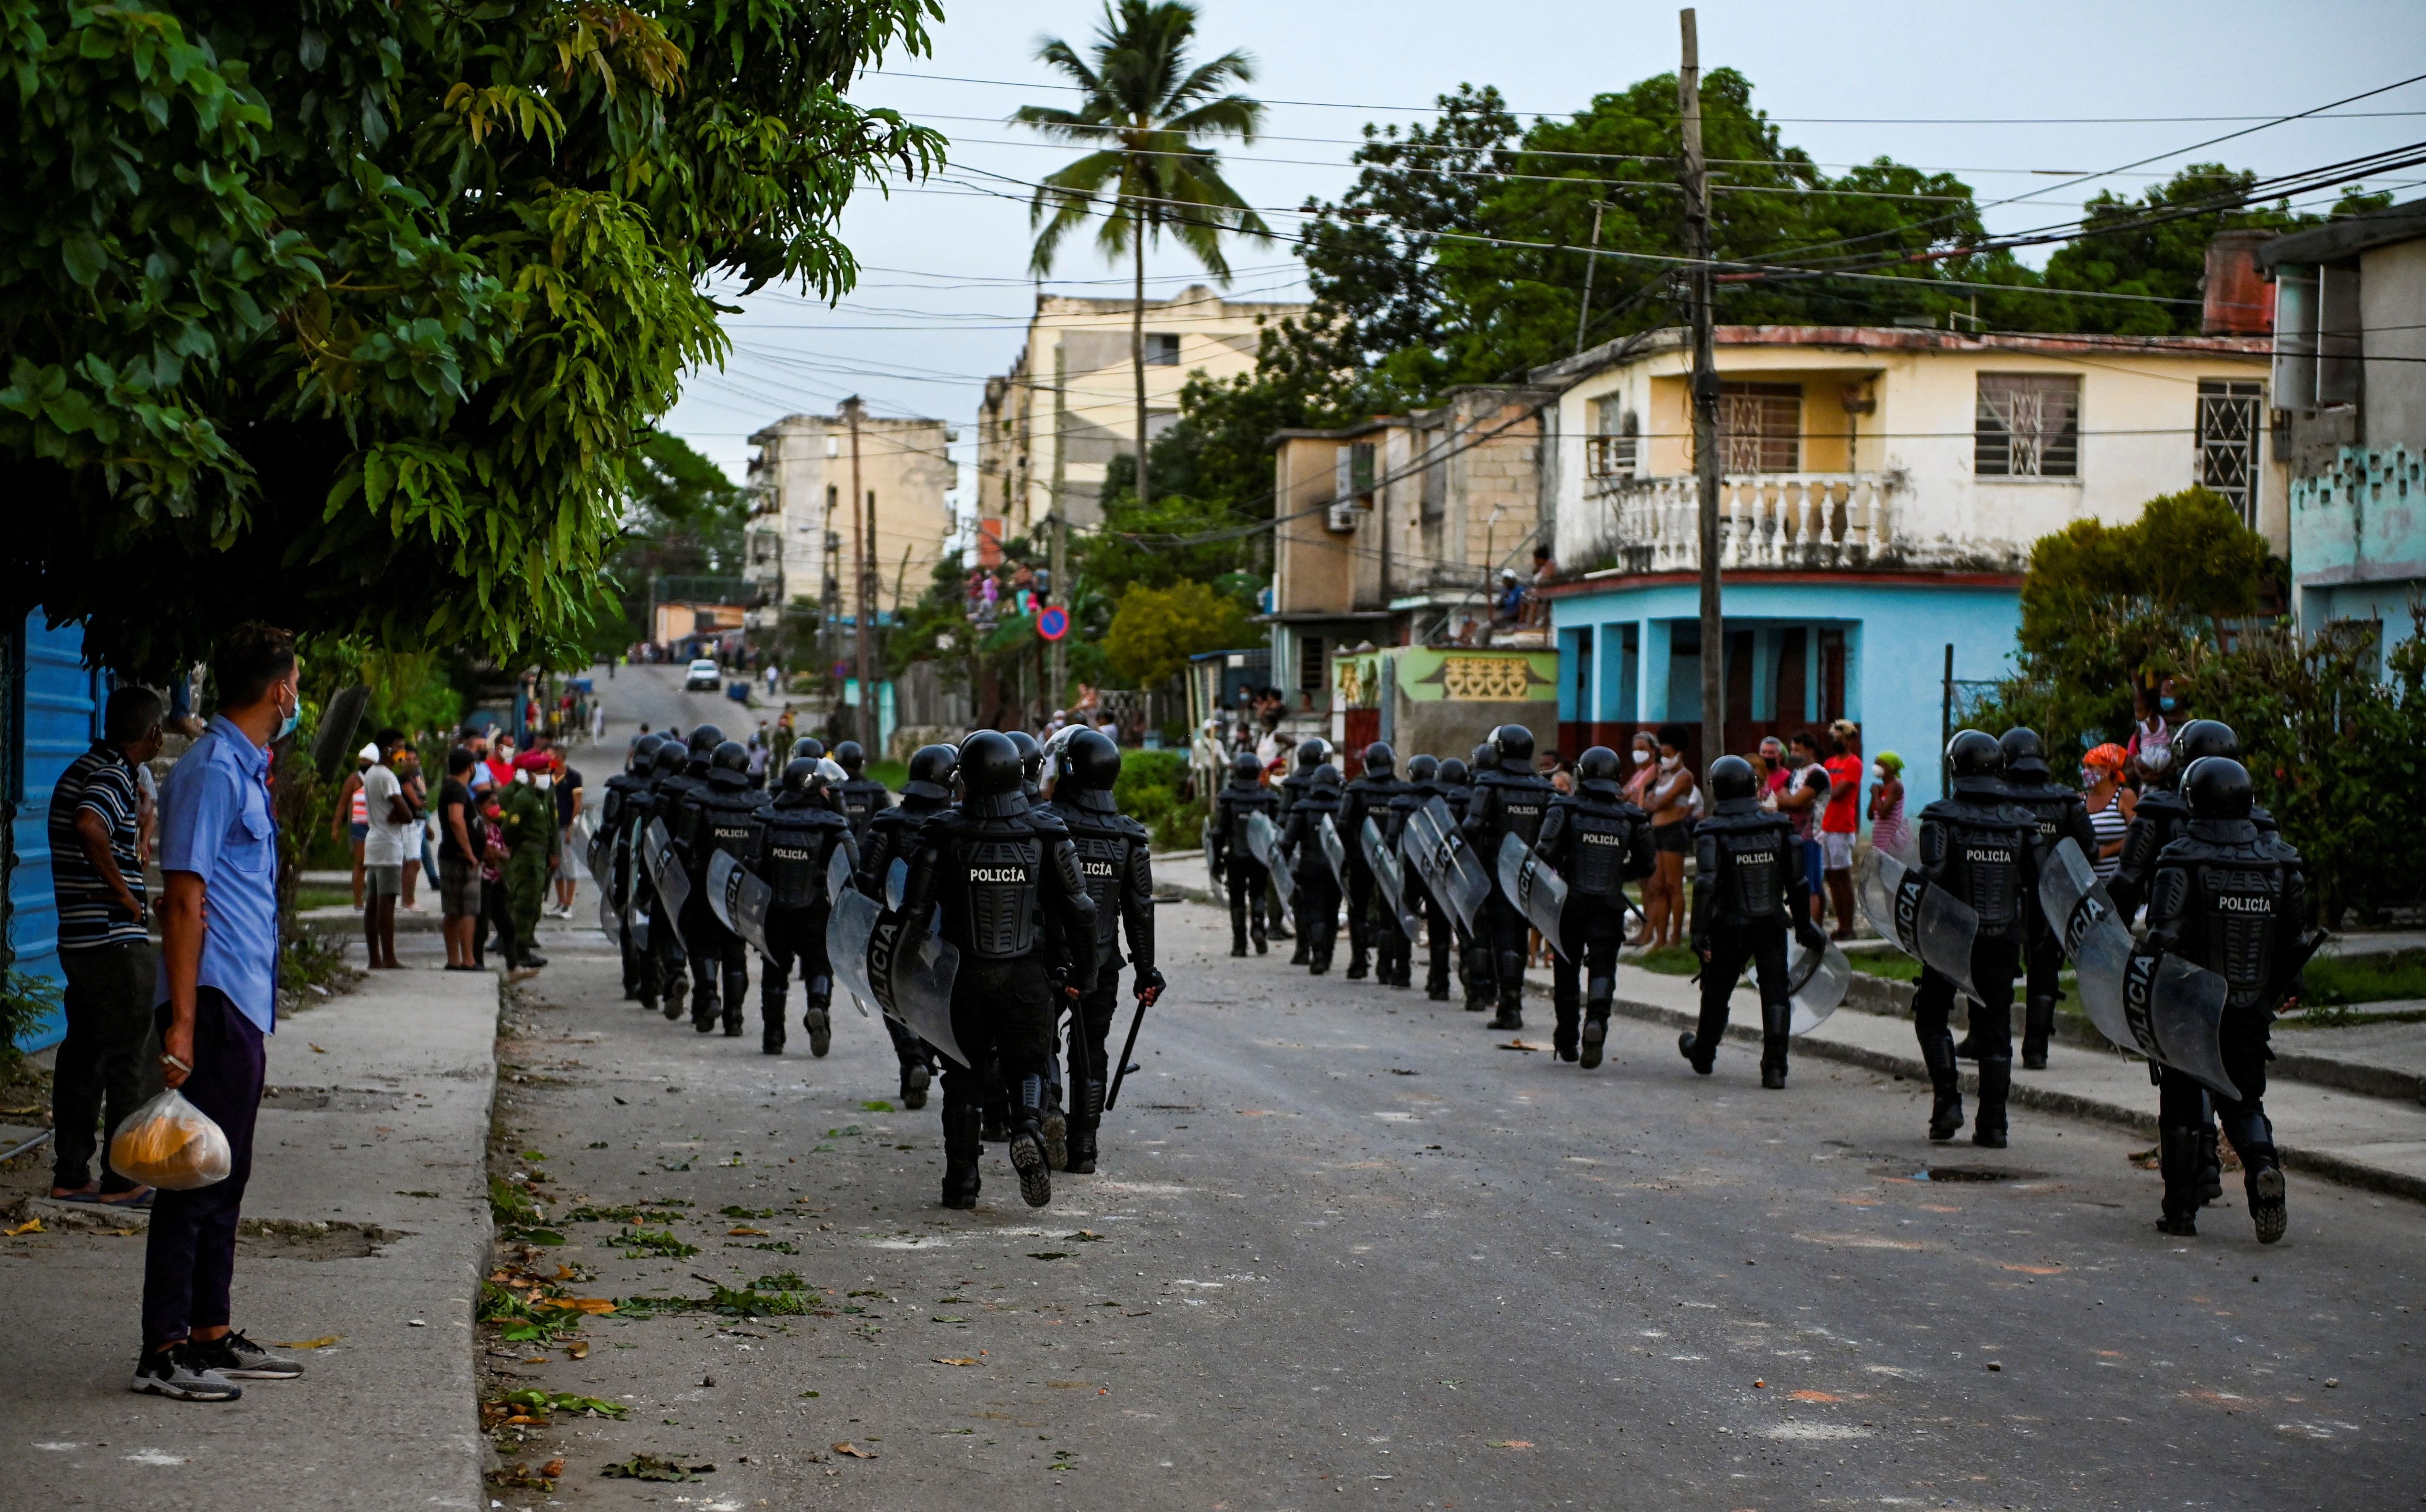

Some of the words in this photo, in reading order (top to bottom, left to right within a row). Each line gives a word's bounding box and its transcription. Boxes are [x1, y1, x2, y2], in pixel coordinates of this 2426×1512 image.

[1508, 805, 1538, 815] POLICÍA
[715, 828, 749, 838] POLICÍA
[1583, 833, 1619, 846] POLICÍA
[773, 848, 808, 860] POLICÍA
[1736, 852, 1774, 865] POLICÍA
[1966, 848, 2011, 864] POLICÍA
[970, 867, 1025, 882] POLICÍA
[1080, 861, 1113, 876] LICÍA
[2219, 896, 2271, 912] POLICÍA
[872, 924, 898, 1010] OLICIA
[2128, 956, 2155, 1048] OLICIA
